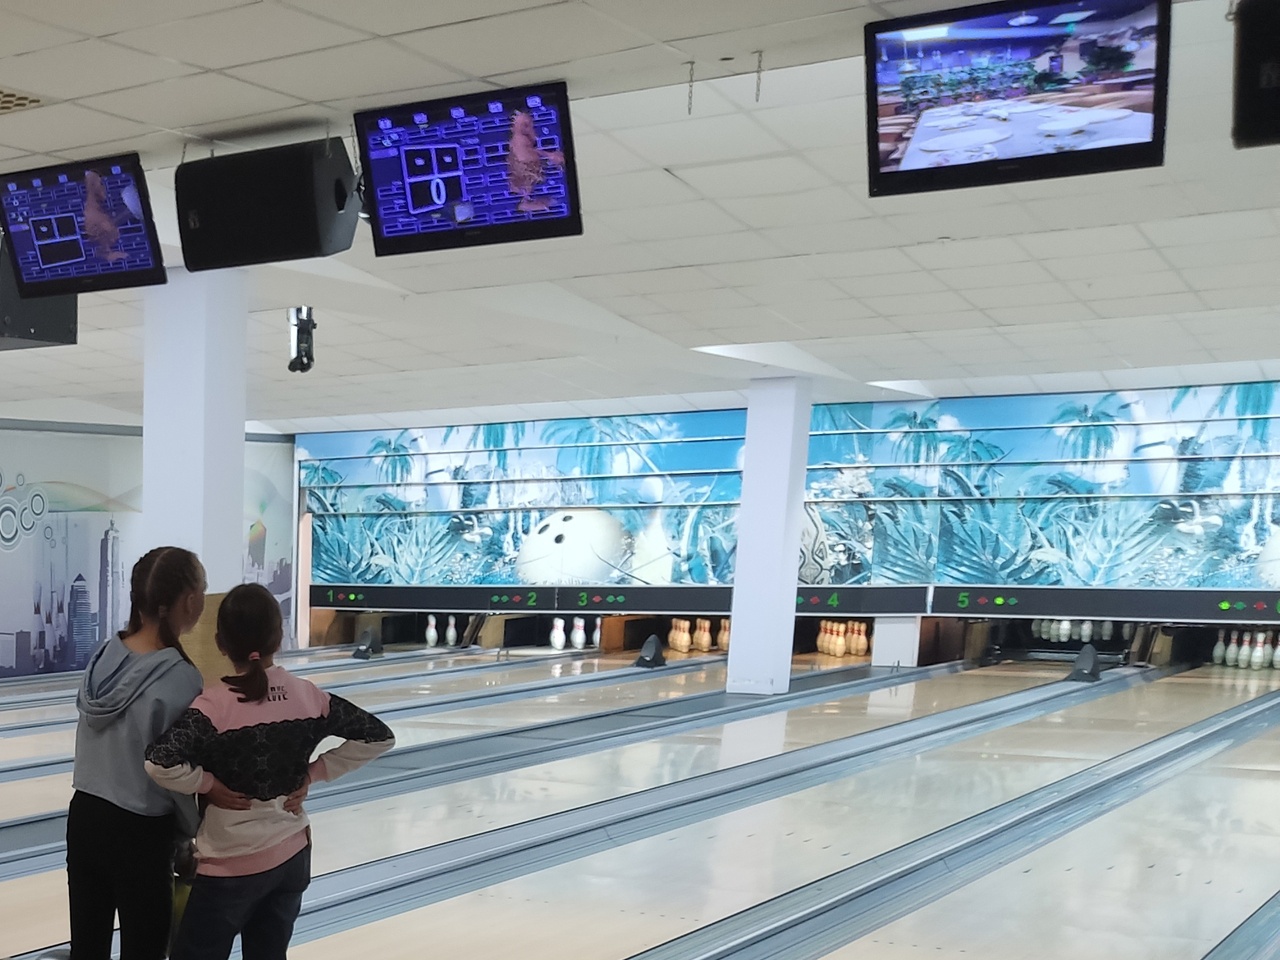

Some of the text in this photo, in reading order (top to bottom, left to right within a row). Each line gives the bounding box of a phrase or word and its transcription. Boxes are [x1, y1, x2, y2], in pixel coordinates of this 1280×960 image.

[326, 589, 334, 603] 1
[527, 591, 537, 606] 2
[578, 591, 588, 606] 3
[827, 592, 839, 607] 4
[957, 592, 970, 608] 5
